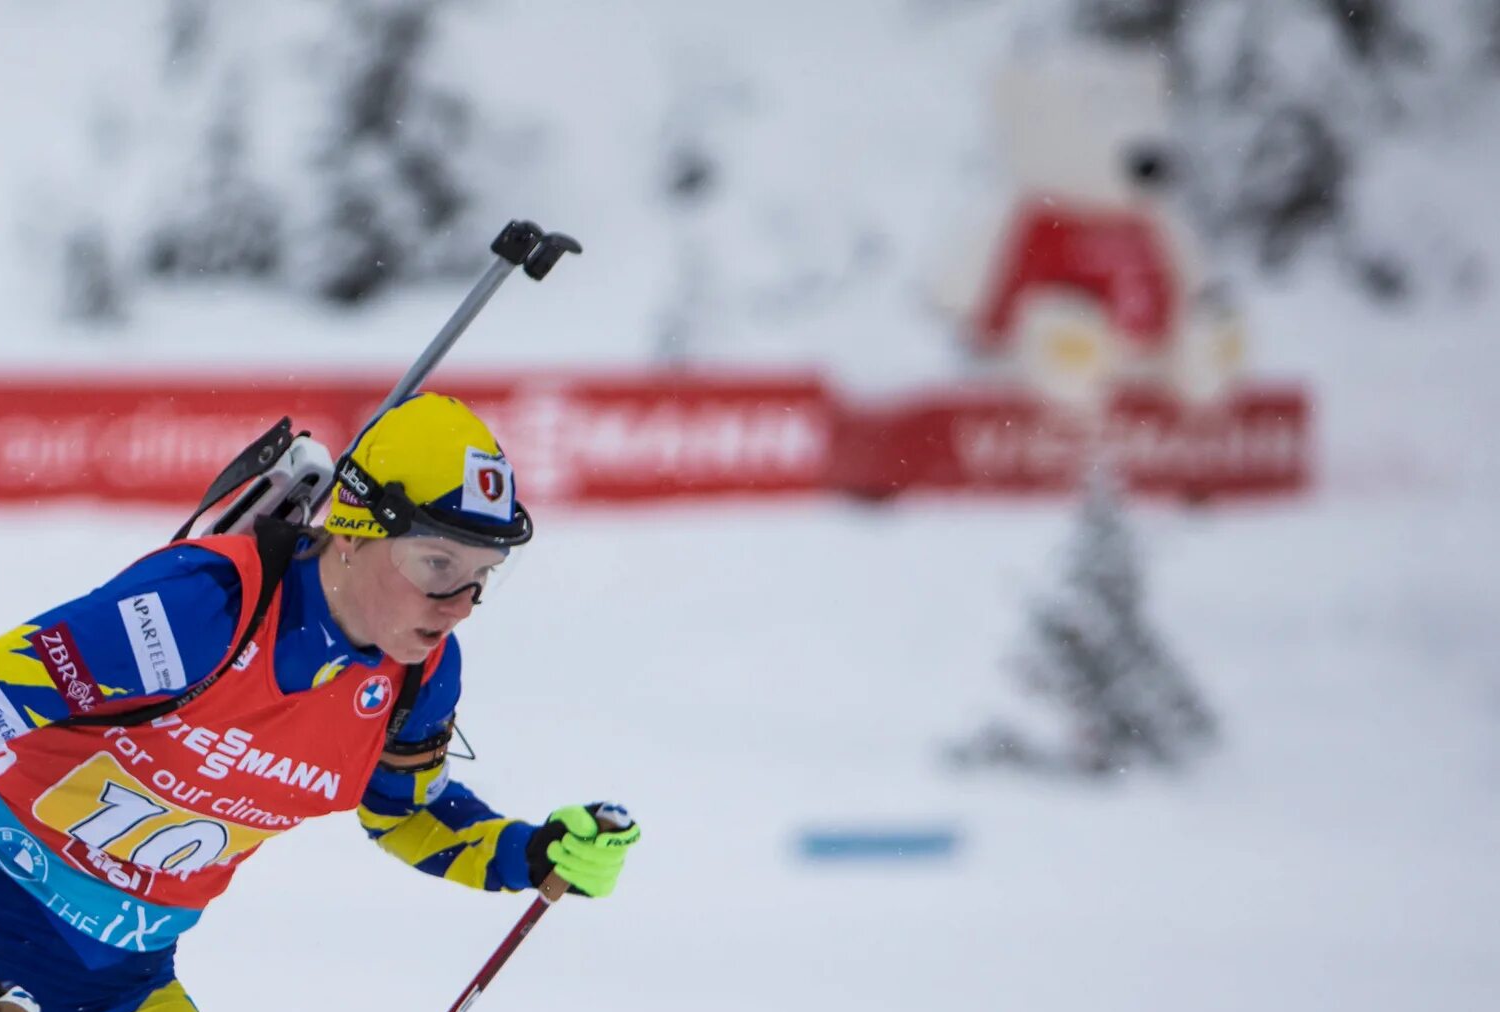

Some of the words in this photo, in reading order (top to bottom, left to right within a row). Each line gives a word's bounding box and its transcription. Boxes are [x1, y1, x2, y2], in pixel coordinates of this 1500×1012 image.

[339, 464, 369, 495] ulbo
[133, 597, 165, 672] APARTEL
[103, 727, 154, 765] for
[152, 769, 212, 805] our
[151, 712, 340, 801] VIESSMANN
[67, 780, 229, 874] 10
